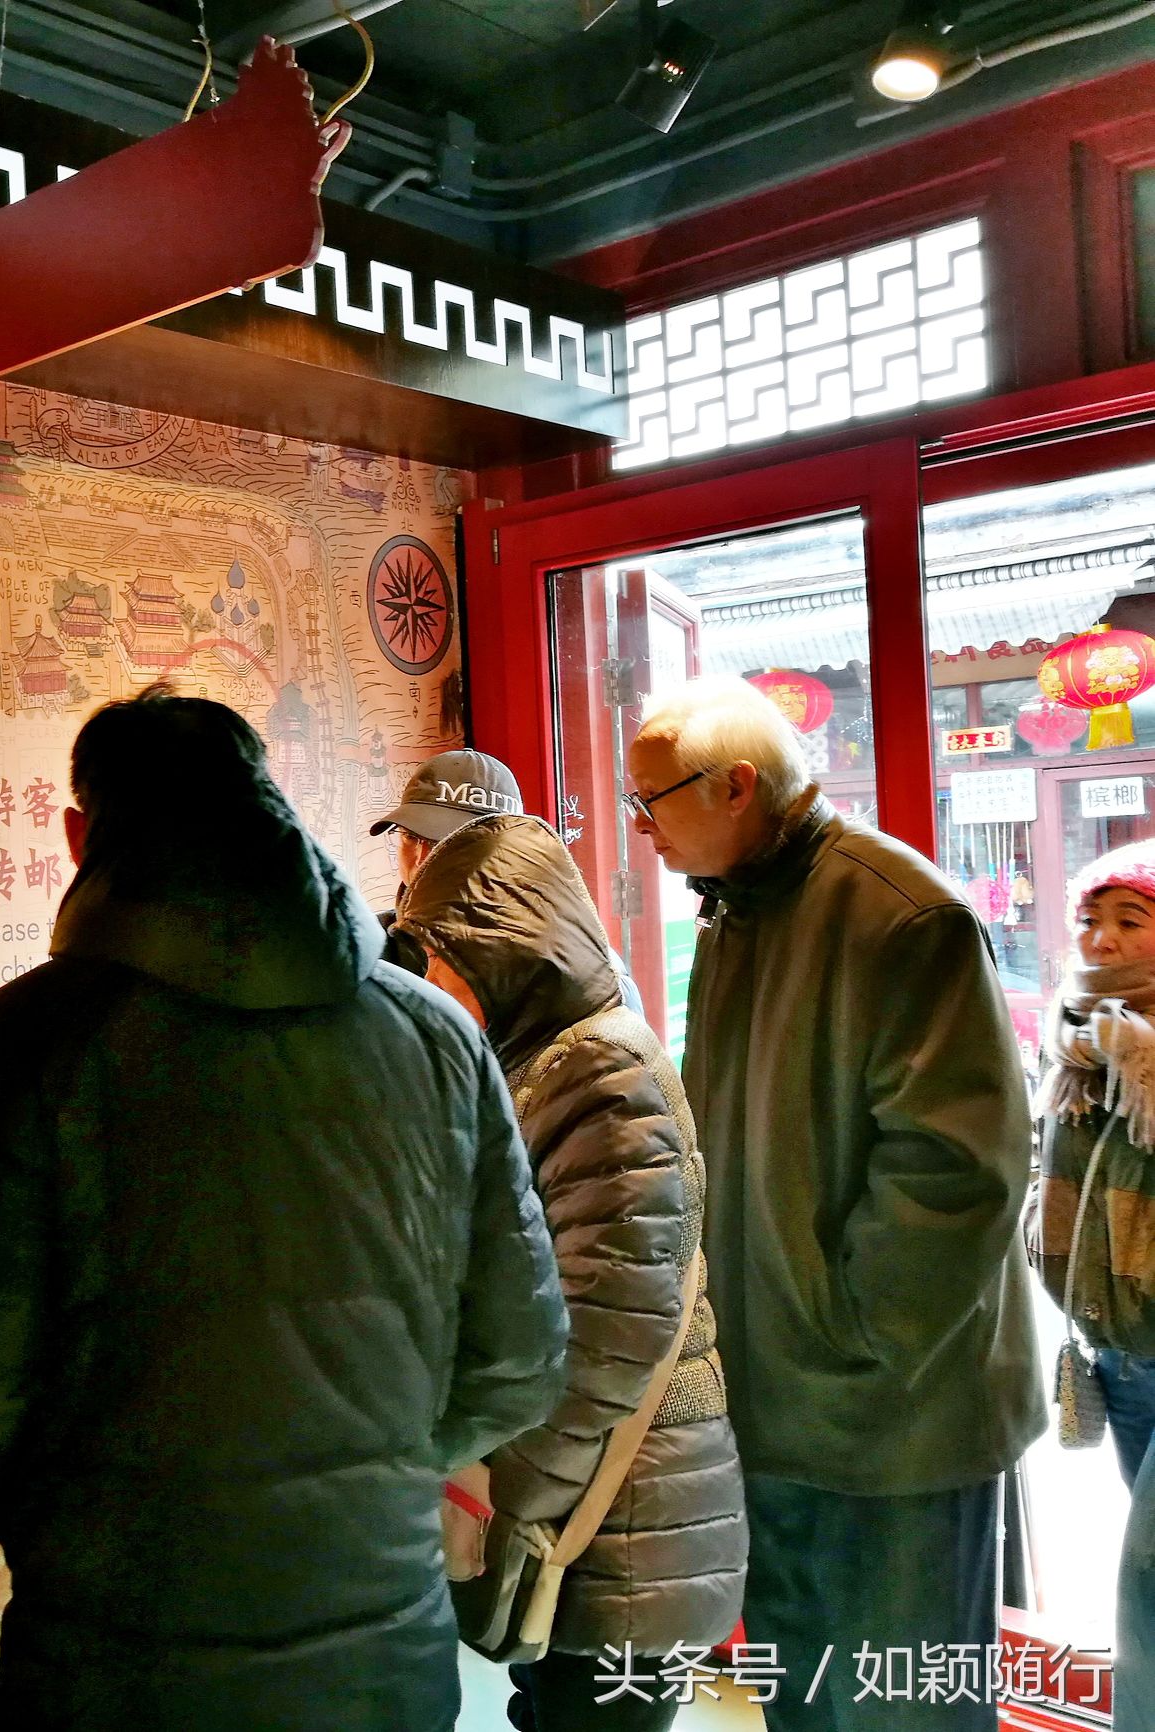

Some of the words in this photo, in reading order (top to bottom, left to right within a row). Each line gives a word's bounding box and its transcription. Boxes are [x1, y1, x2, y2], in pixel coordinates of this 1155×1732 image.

[77, 449, 120, 465] ALTAR
[125, 447, 140, 461] OF
[145, 418, 182, 454] EARTH
[391, 501, 421, 515] NORTH
[16, 559, 44, 573] MEN
[38, 580, 51, 592] OF
[1086, 784, 1139, 808] 槟榔
